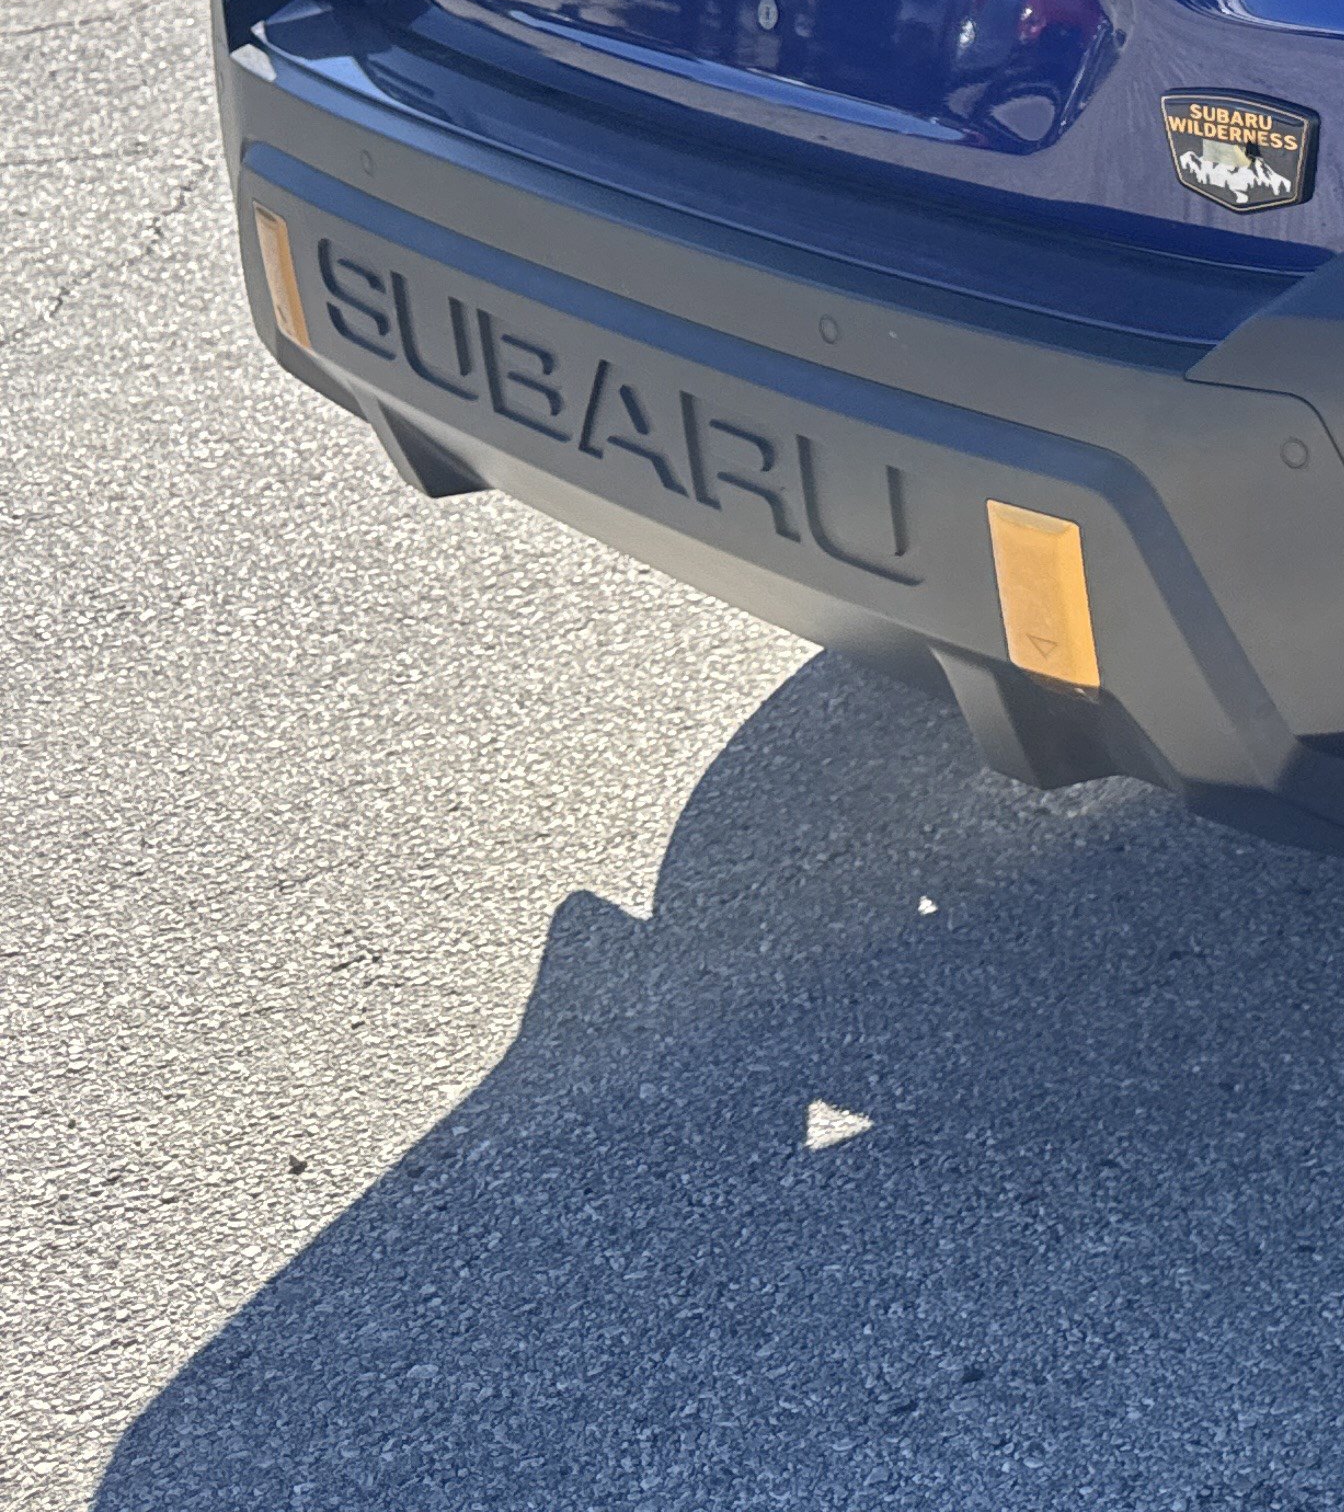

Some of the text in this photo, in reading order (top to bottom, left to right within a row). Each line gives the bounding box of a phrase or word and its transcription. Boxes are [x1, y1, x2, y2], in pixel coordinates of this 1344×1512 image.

[1168, 116, 1299, 152] WILDERNESS
[1189, 103, 1273, 131] SUBARU
[317, 237, 925, 587] SUBARU
